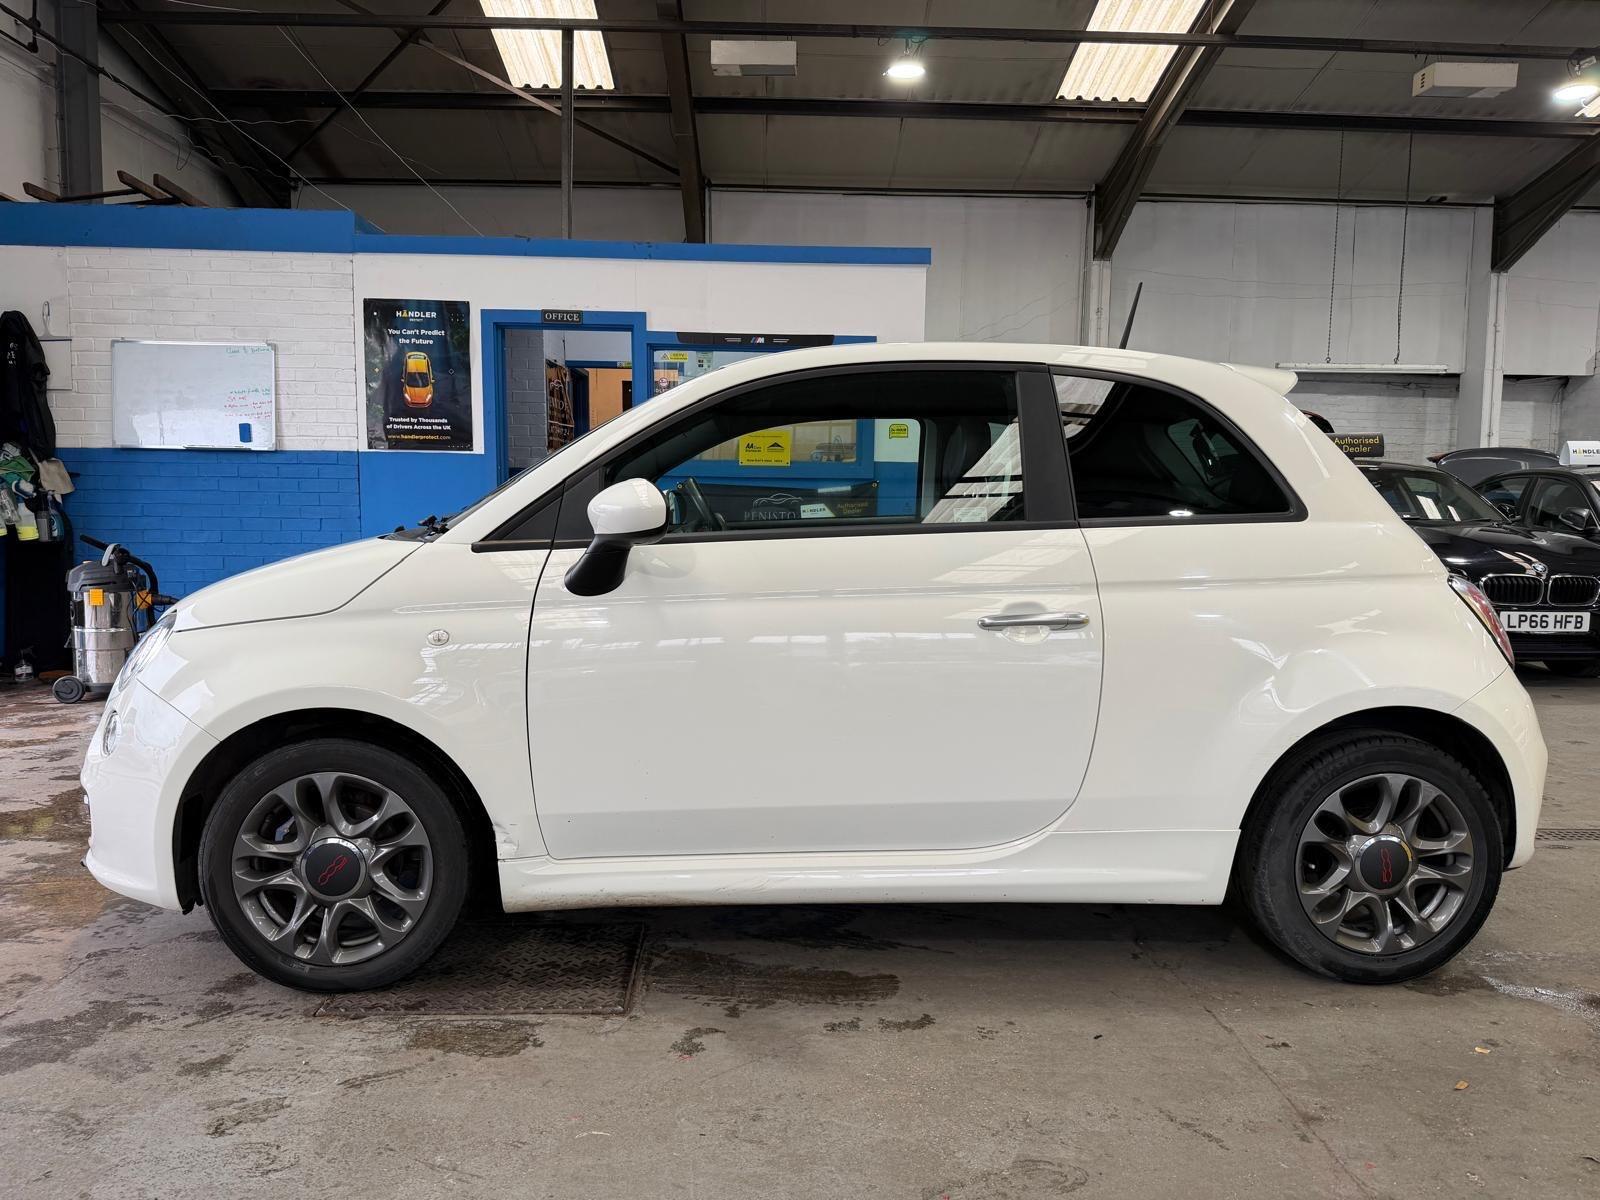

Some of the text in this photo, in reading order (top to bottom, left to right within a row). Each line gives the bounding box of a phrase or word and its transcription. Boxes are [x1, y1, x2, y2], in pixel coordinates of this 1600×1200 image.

[396, 310, 437, 318] HANDLER
[545, 312, 580, 322] OFFICE
[1334, 435, 1380, 445] Authorised
[1342, 445, 1372, 453] Dealer
[1507, 614, 1584, 629] LP66 HFB
